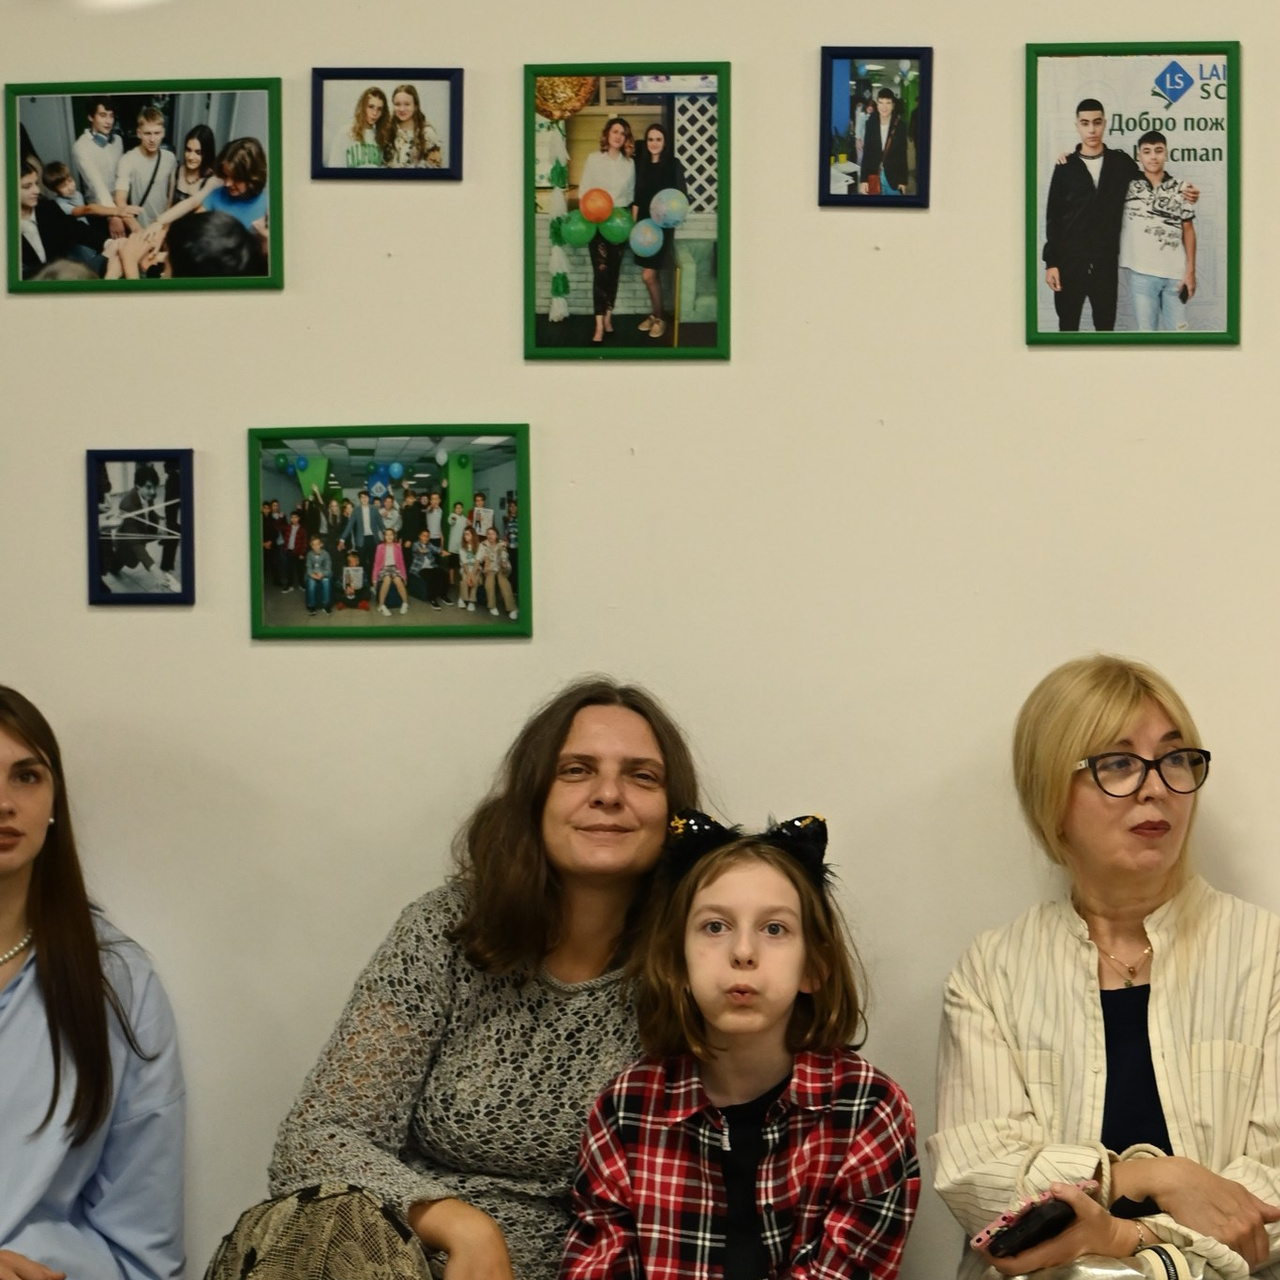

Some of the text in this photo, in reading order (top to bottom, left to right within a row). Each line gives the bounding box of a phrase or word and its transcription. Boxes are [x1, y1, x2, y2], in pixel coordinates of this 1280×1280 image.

[1165, 73, 1185, 90] LS
[1200, 83, 1227, 100] SC
[1109, 111, 1225, 136] Добро пож
